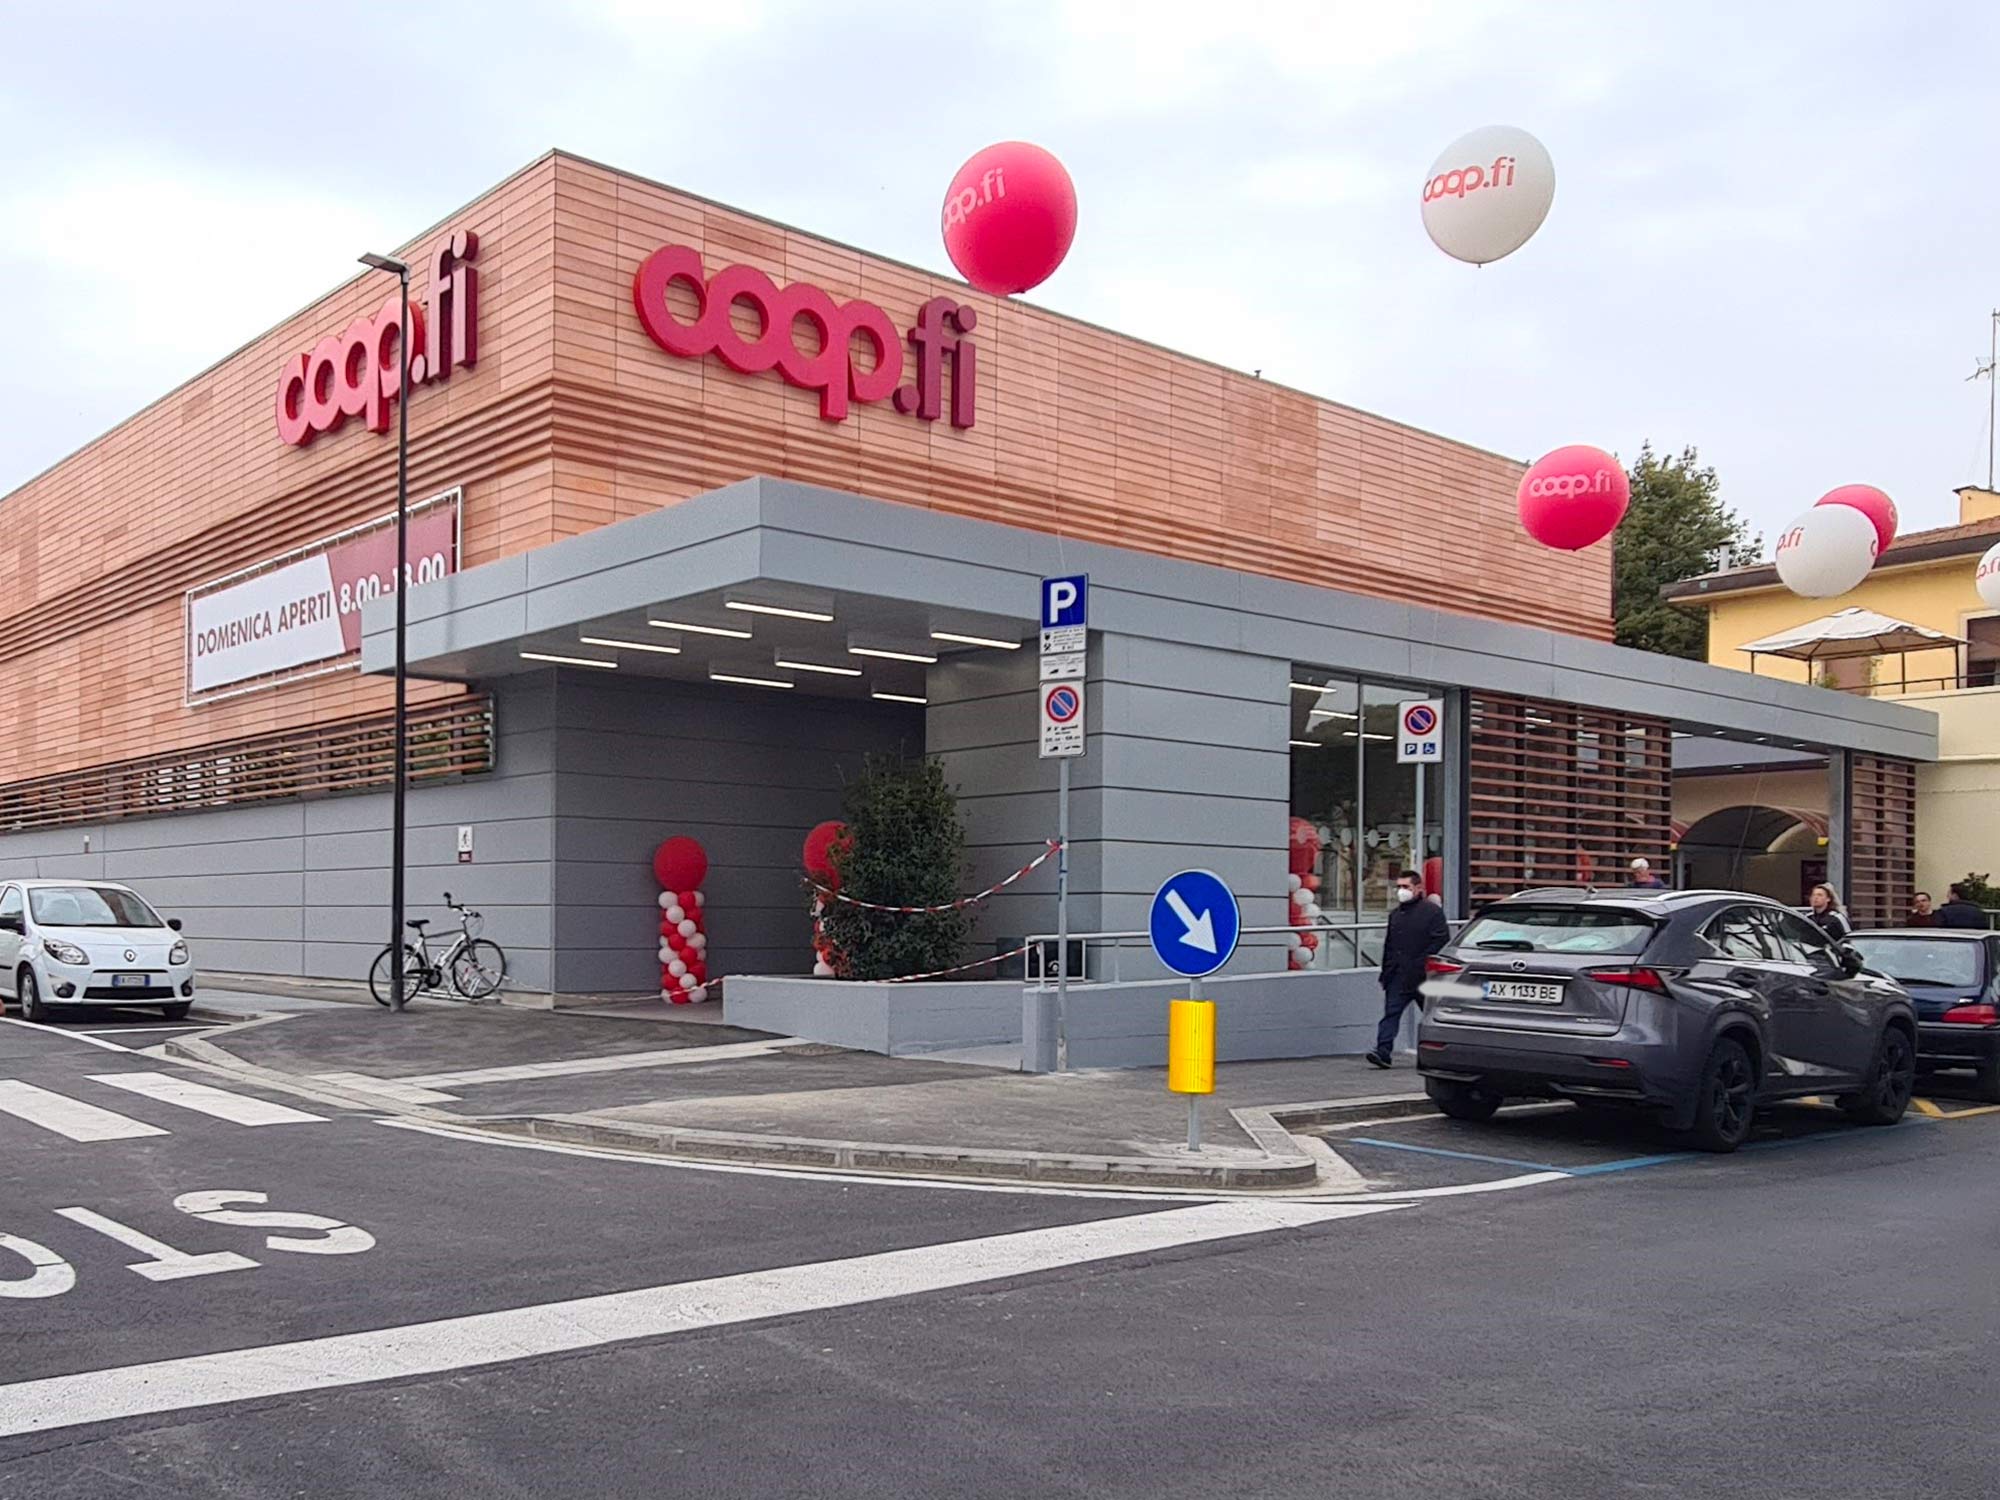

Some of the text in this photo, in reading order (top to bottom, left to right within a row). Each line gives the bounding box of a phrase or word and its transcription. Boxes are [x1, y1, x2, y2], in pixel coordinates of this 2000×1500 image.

[276, 230, 478, 446] coop.fi
[633, 244, 977, 429] coop.fi
[1529, 469, 1611, 499] coop.fi
[197, 611, 272, 657] DOMENICA
[277, 590, 331, 633] APERTI
[1049, 581, 1077, 624] P
[1406, 744, 1416, 754] P
[1489, 983, 1558, 1000] AX 1133 BE
